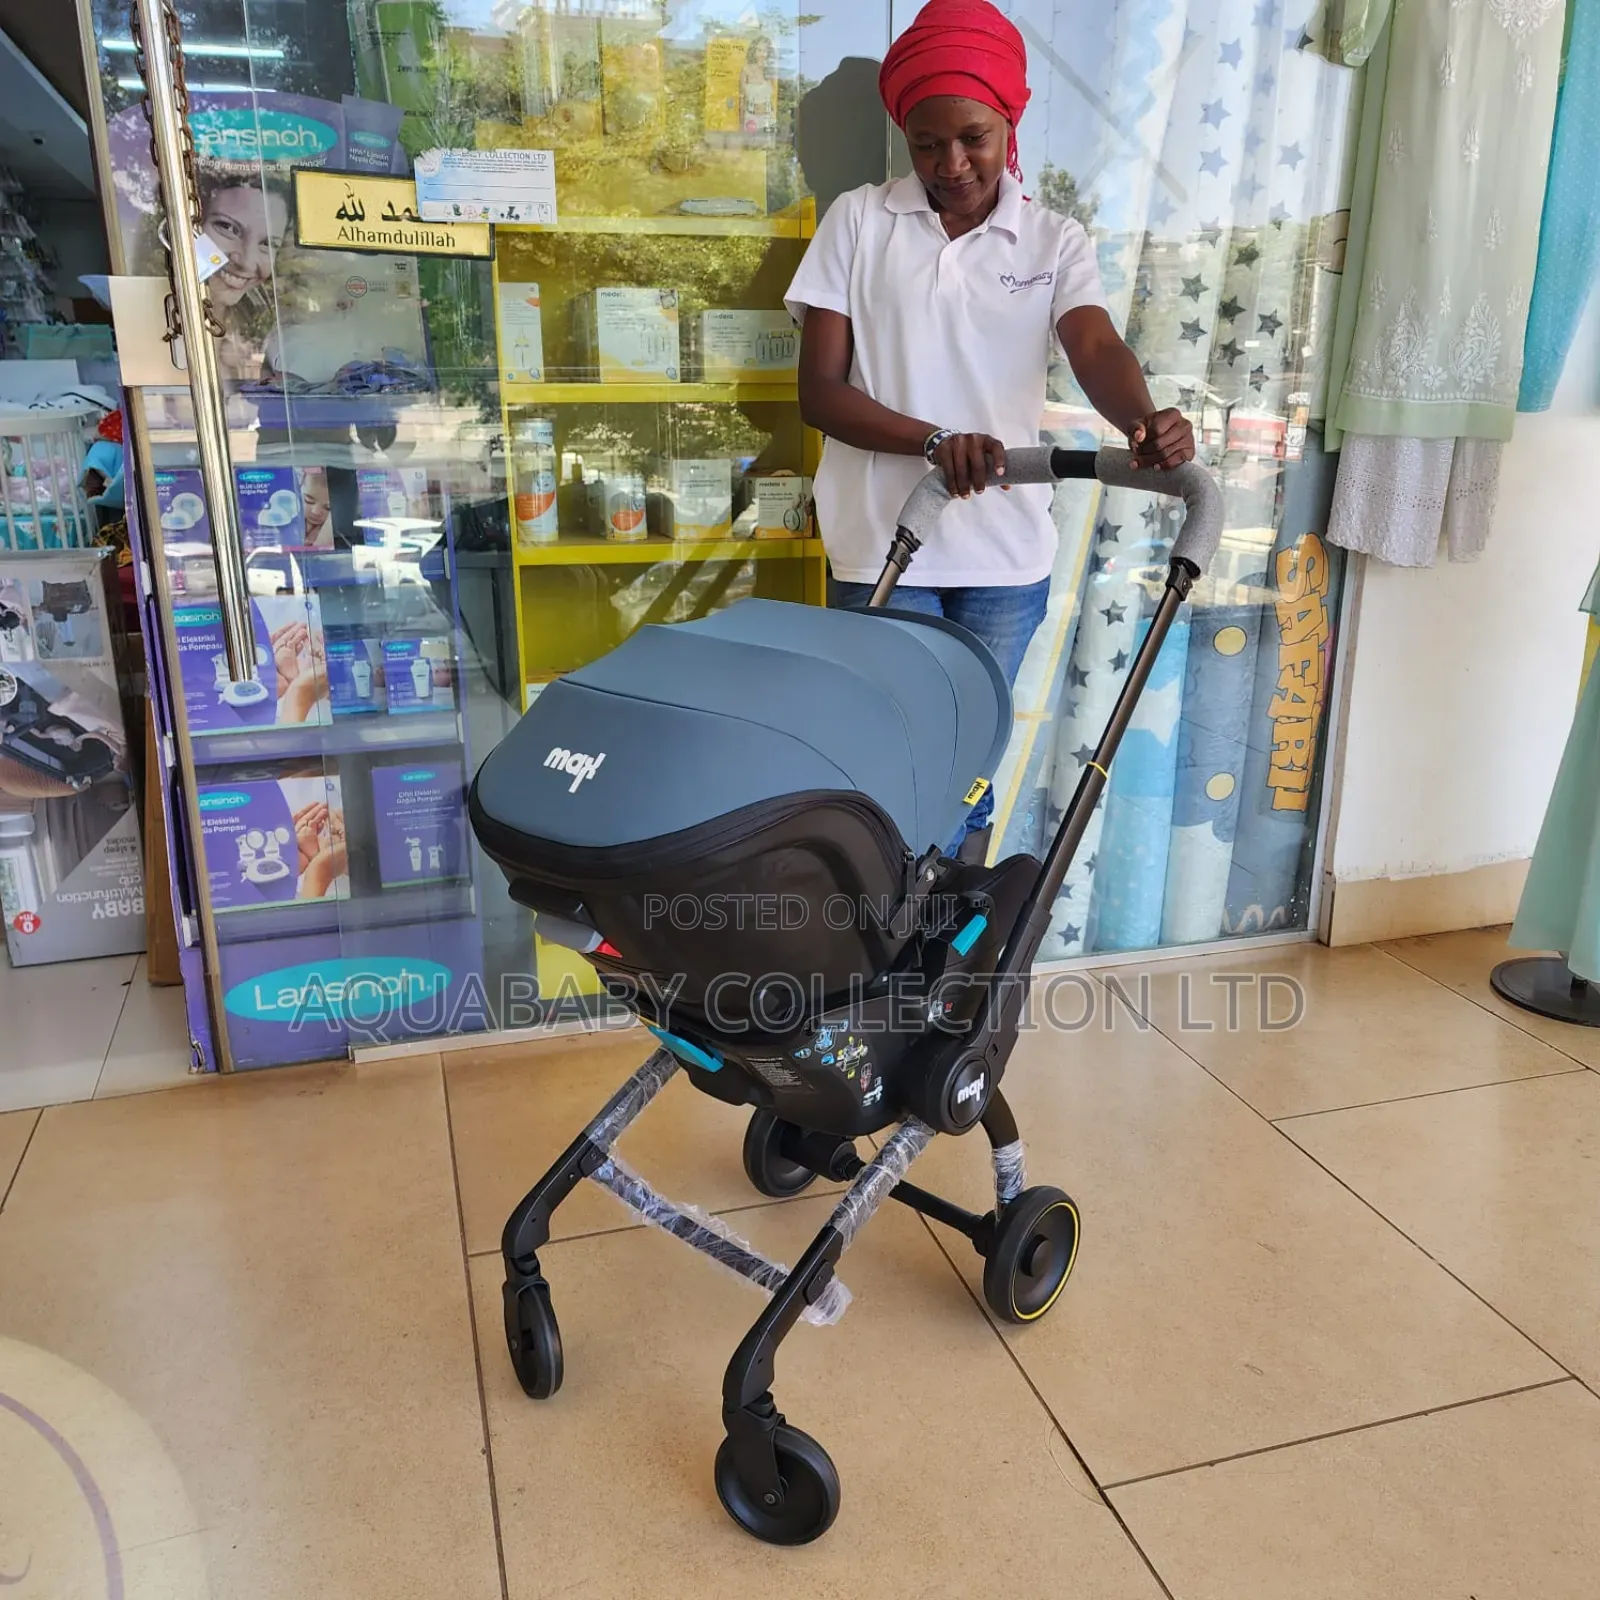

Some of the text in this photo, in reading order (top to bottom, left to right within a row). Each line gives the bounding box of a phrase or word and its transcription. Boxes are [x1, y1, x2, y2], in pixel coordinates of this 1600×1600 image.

[337, 225, 456, 248] Alhamdulillah
[199, 795, 244, 806] ansinoh
[56, 885, 143, 903] Multifunction
[92, 897, 145, 919] BABY
[254, 968, 425, 1011] Lansinoh
